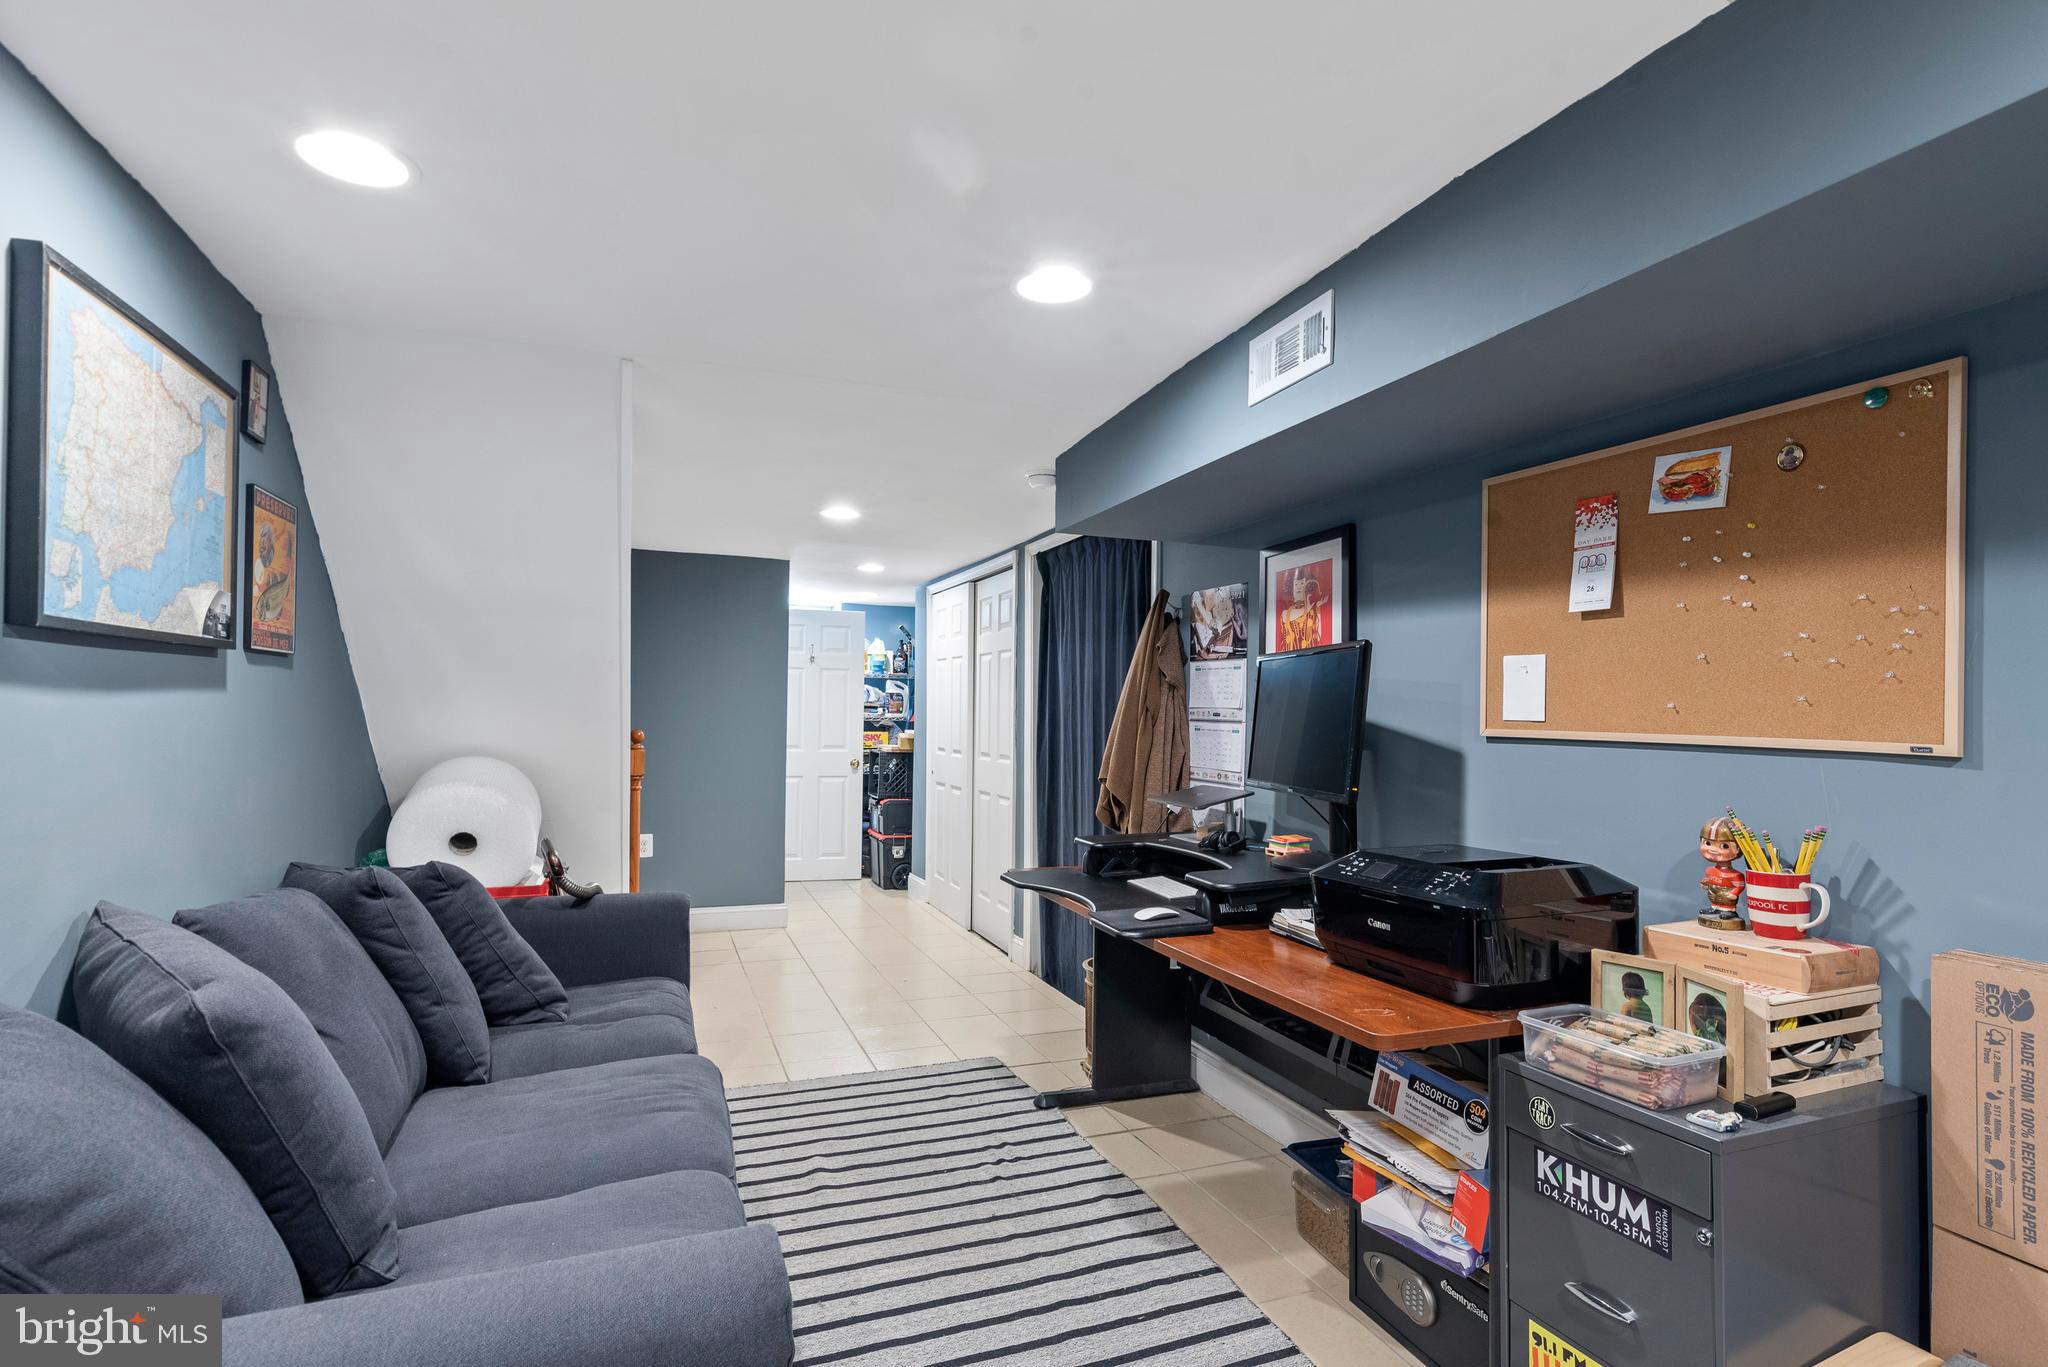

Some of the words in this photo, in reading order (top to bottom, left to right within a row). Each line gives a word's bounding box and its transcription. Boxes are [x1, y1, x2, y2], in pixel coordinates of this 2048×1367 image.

[864, 733, 881, 742] SKY
[1367, 918, 1390, 931] Canon
[1711, 944, 1729, 954] No.5
[1975, 981, 1985, 1014] OPTIONS
[1985, 984, 2000, 1017] ECO
[1983, 1048, 1991, 1064] Trees
[2021, 1032, 2035, 1067] MADE
[1993, 1061, 2001, 1083] Million
[1413, 1080, 1459, 1111] ASSORTED
[2021, 1069, 2035, 1104] FROM
[1470, 1103, 1486, 1119] 504
[1532, 1107, 1552, 1127] TRACK
[1534, 1099, 1549, 1115] FLAT
[1984, 1102, 1992, 1125] Gallons
[1471, 1115, 1482, 1124] COIN
[2021, 1107, 2035, 1138] 100%
[1984, 1134, 1992, 1153] Water
[2021, 1141, 2036, 1201] RECYCLED
[1460, 1176, 1477, 1192] STAPLES
[1536, 1149, 1651, 1232] KHUM
[1994, 1186, 2002, 1208] Million
[1536, 1181, 1588, 1215] 104.7FM
[1593, 1208, 1652, 1247] 104.3FM
[2022, 1203, 2037, 1245] PAPER.
[1445, 1285, 1488, 1322] SentrySafe
[1531, 1331, 1557, 1357] 91.1
